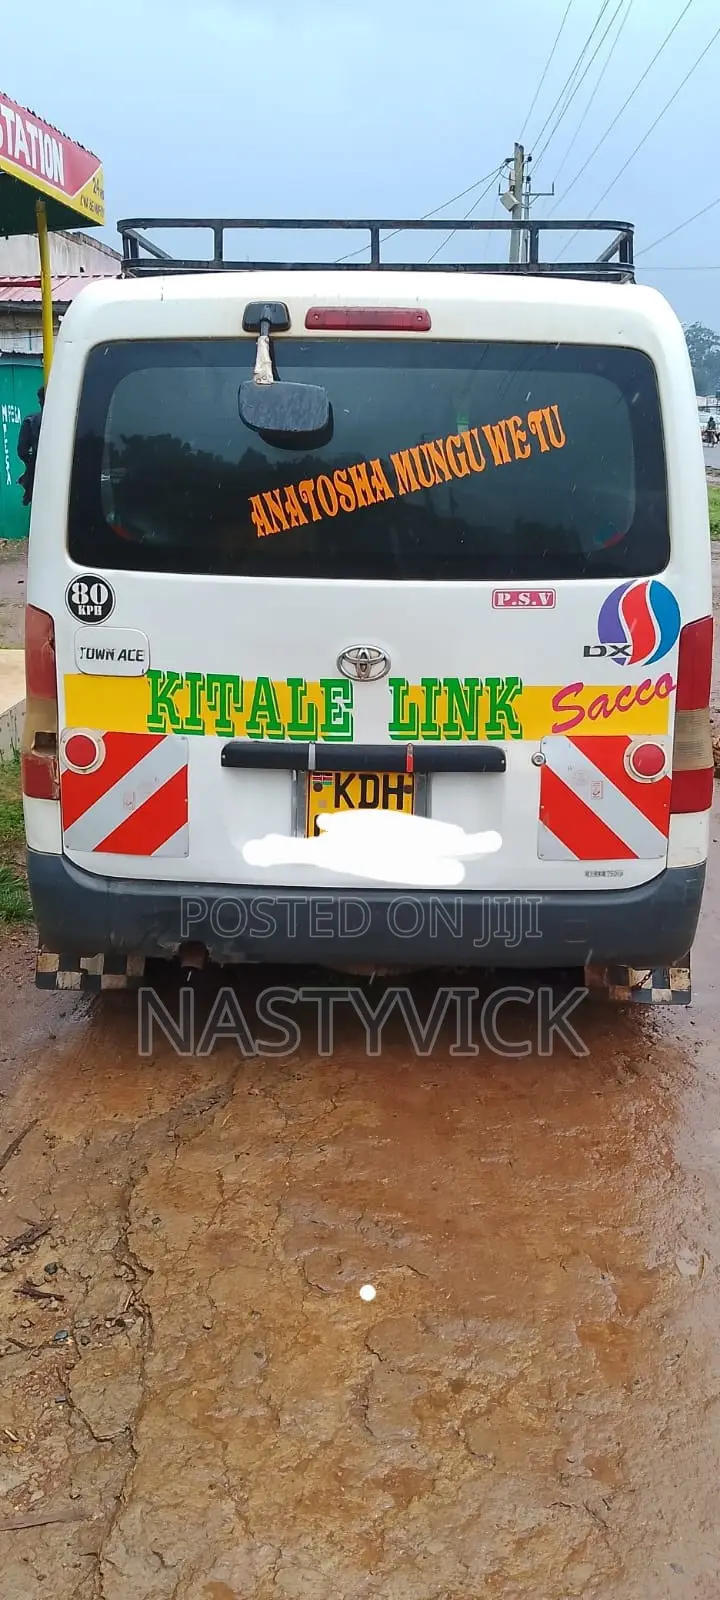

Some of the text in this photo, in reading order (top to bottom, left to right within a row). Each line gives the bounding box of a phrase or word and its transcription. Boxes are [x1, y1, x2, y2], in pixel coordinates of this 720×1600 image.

[248, 457, 394, 537] ANATOSHA
[389, 428, 486, 496] MUNGU
[71, 582, 109, 605] 80
[496, 592, 553, 606] P.S.V
[77, 605, 103, 616] KPH
[117, 649, 144, 662] ACE
[583, 644, 633, 658] DX
[147, 669, 677, 741] KITALE LINK Sacco
[333, 772, 405, 810] KDH
